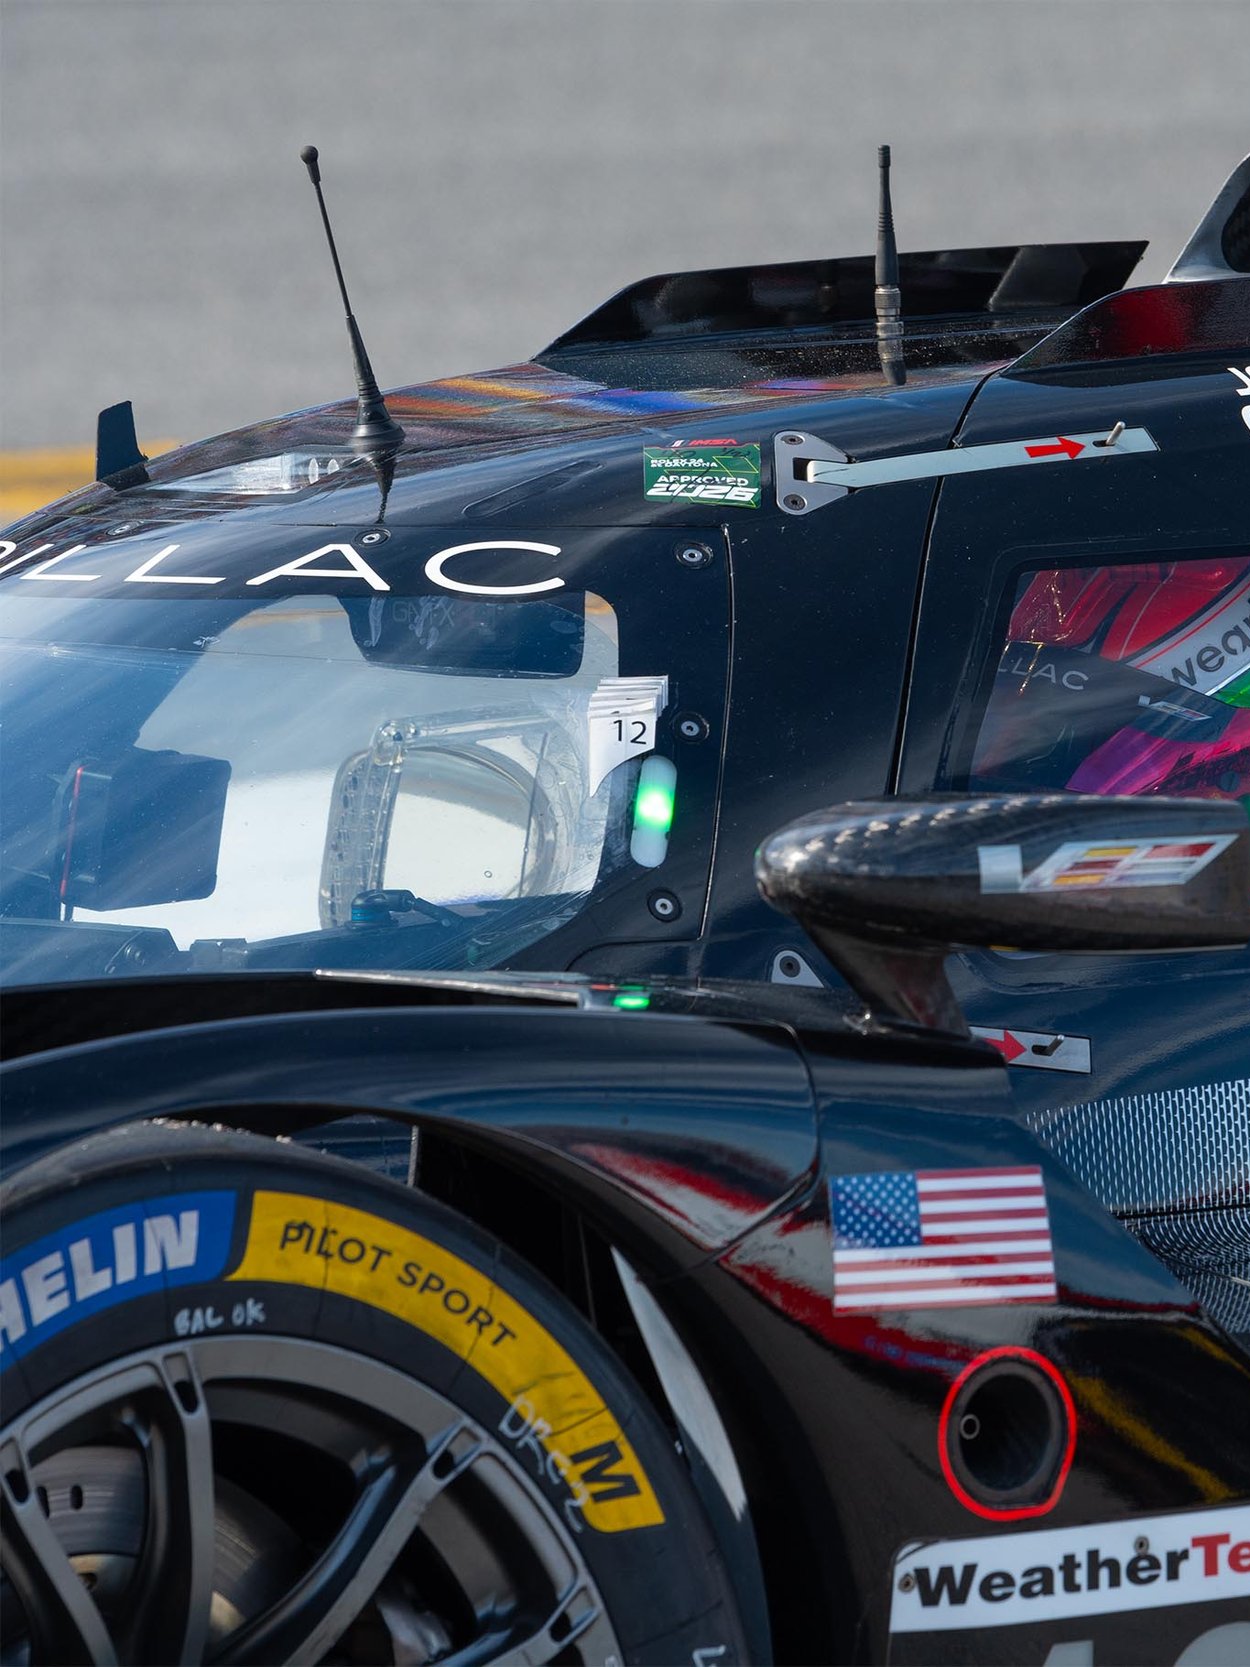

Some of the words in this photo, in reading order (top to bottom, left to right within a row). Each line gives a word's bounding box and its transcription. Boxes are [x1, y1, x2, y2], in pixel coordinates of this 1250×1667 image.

[646, 483, 759, 501] 2026
[656, 475, 749, 487] APPROVED
[0, 539, 565, 594] ILLAC
[612, 718, 648, 746] 12
[279, 1220, 393, 1273] PILOT
[396, 1261, 517, 1347] SPORT
[573, 1440, 643, 1504] M
